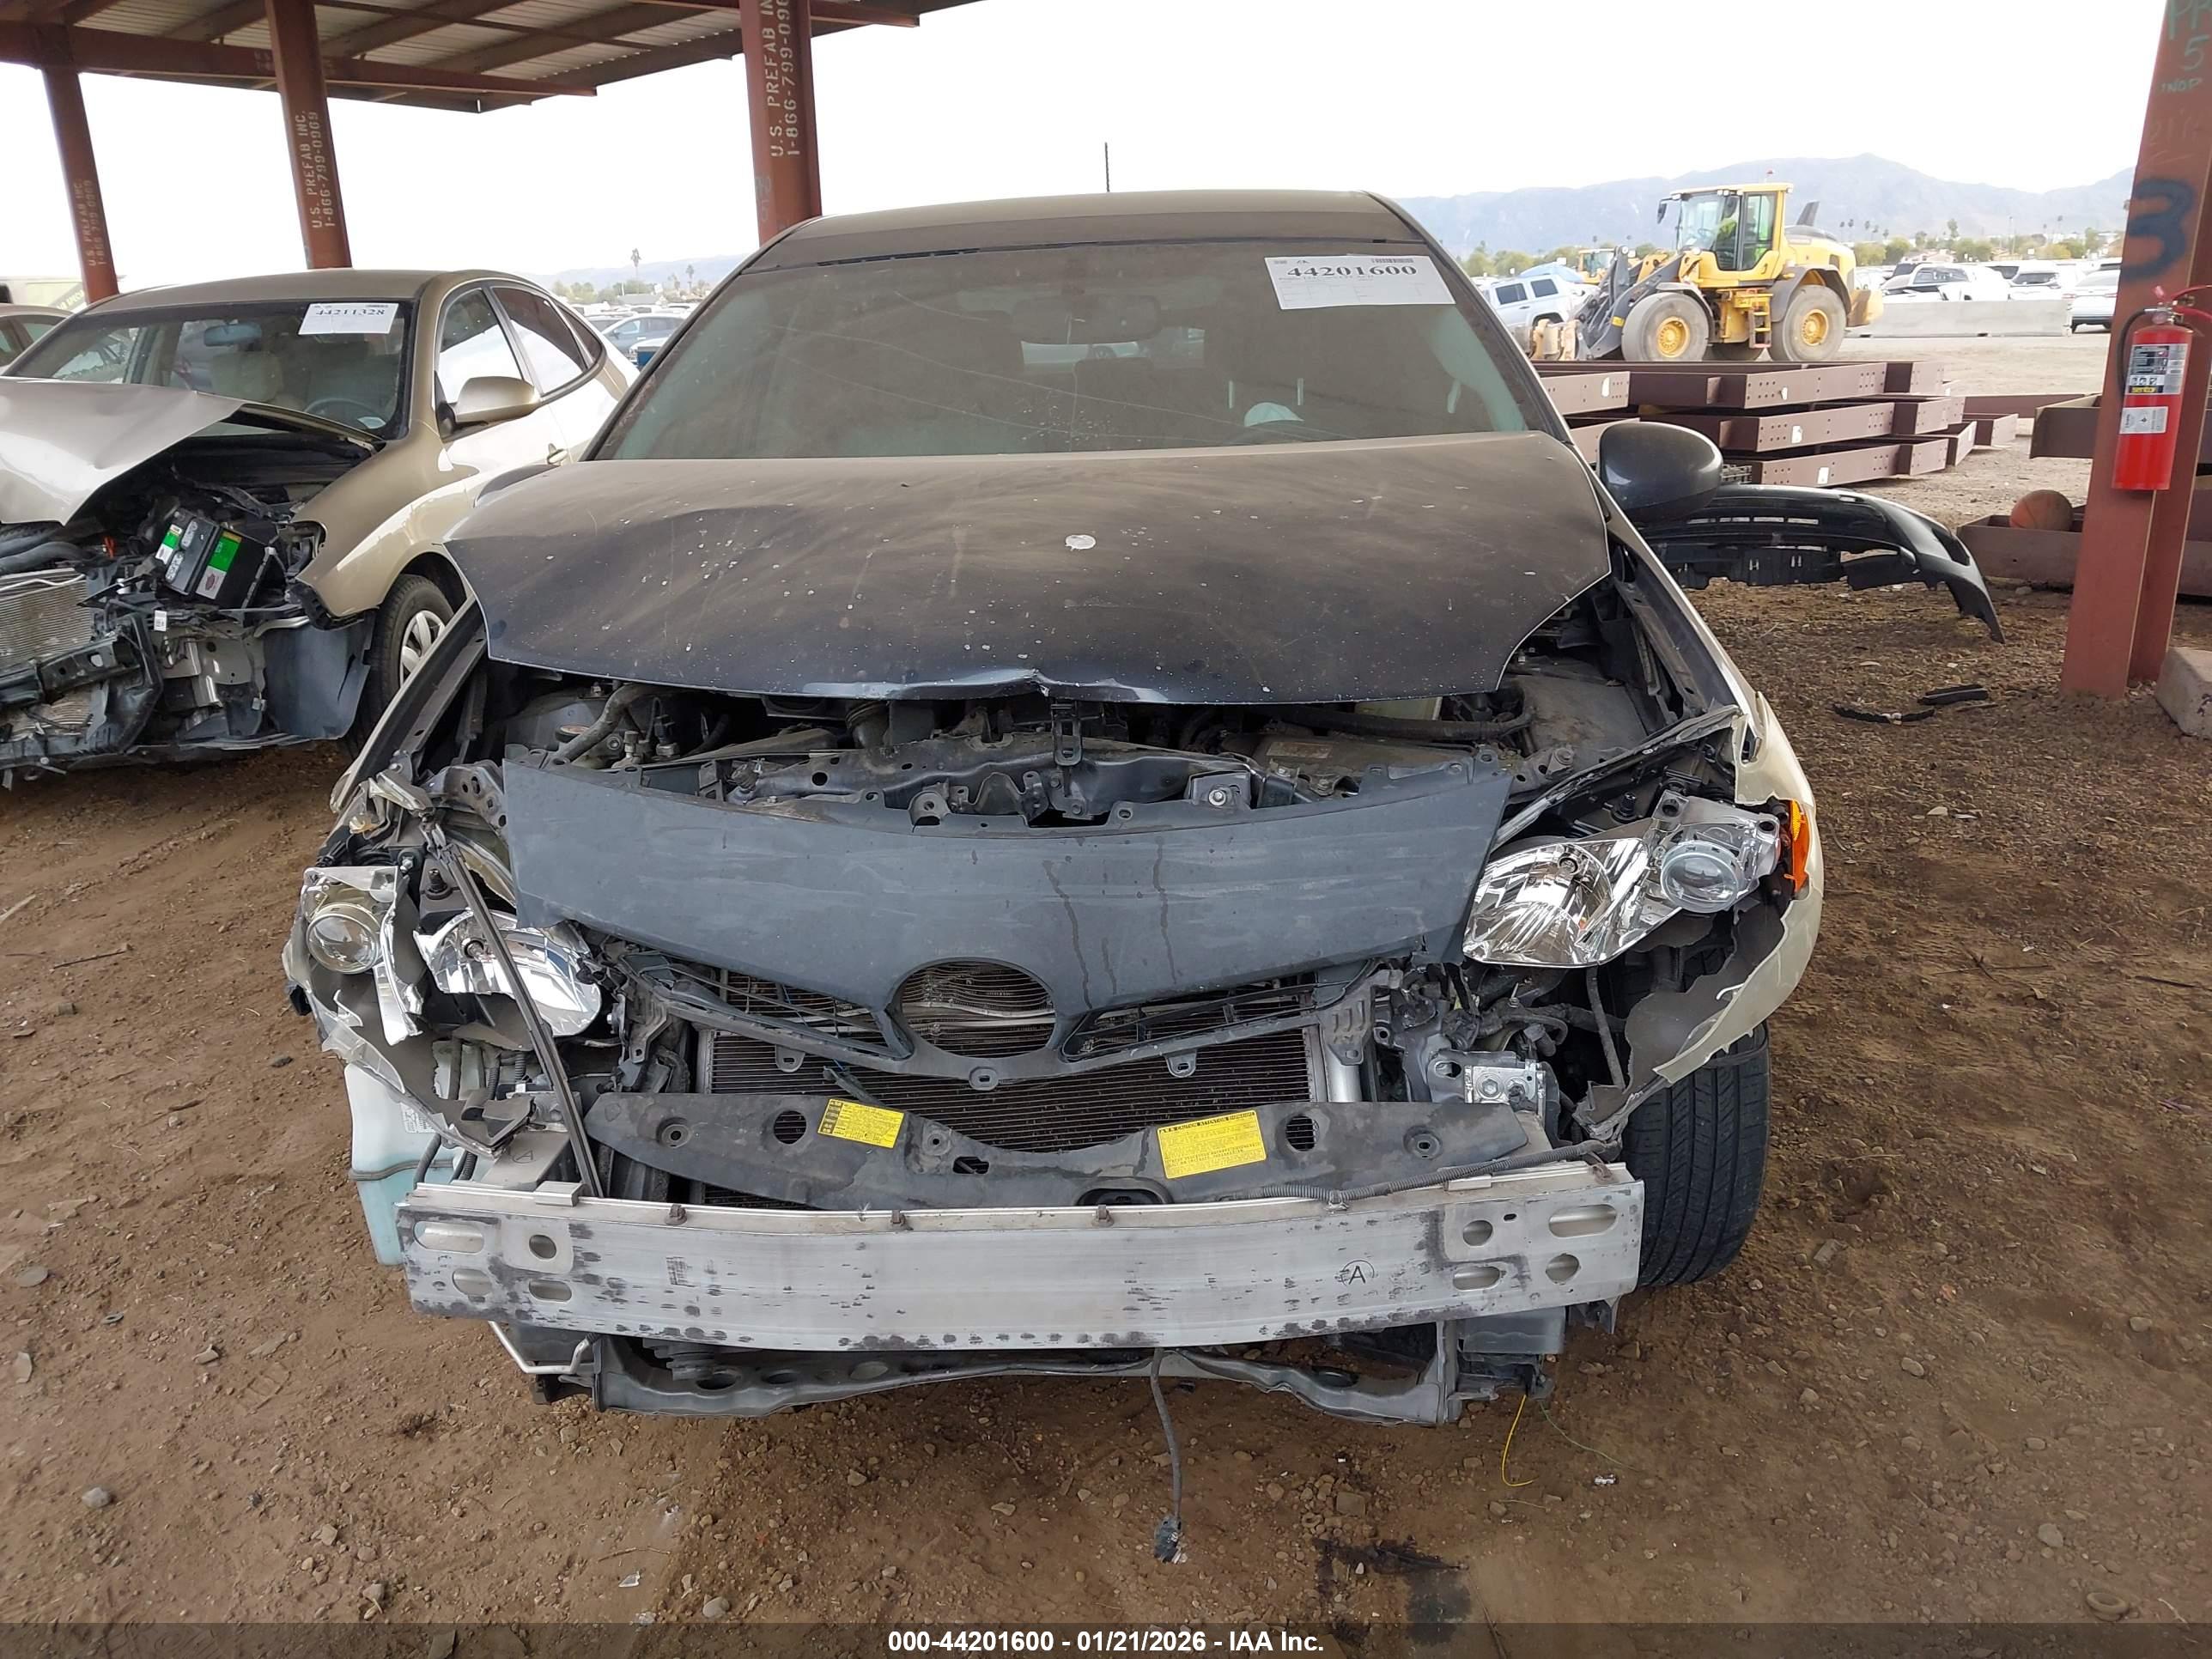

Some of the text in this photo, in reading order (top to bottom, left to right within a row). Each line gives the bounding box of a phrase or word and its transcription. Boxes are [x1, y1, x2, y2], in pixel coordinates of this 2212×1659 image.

[763, 27, 781, 106] PREFAB
[2180, 34, 2210, 71] 5
[769, 119, 783, 157] U.S.
[295, 111, 323, 228] U.S. PREFAB INC.
[2122, 178, 2193, 283] 3
[1287, 265, 1418, 276] 44201600
[1348, 1265, 1366, 1285] A
